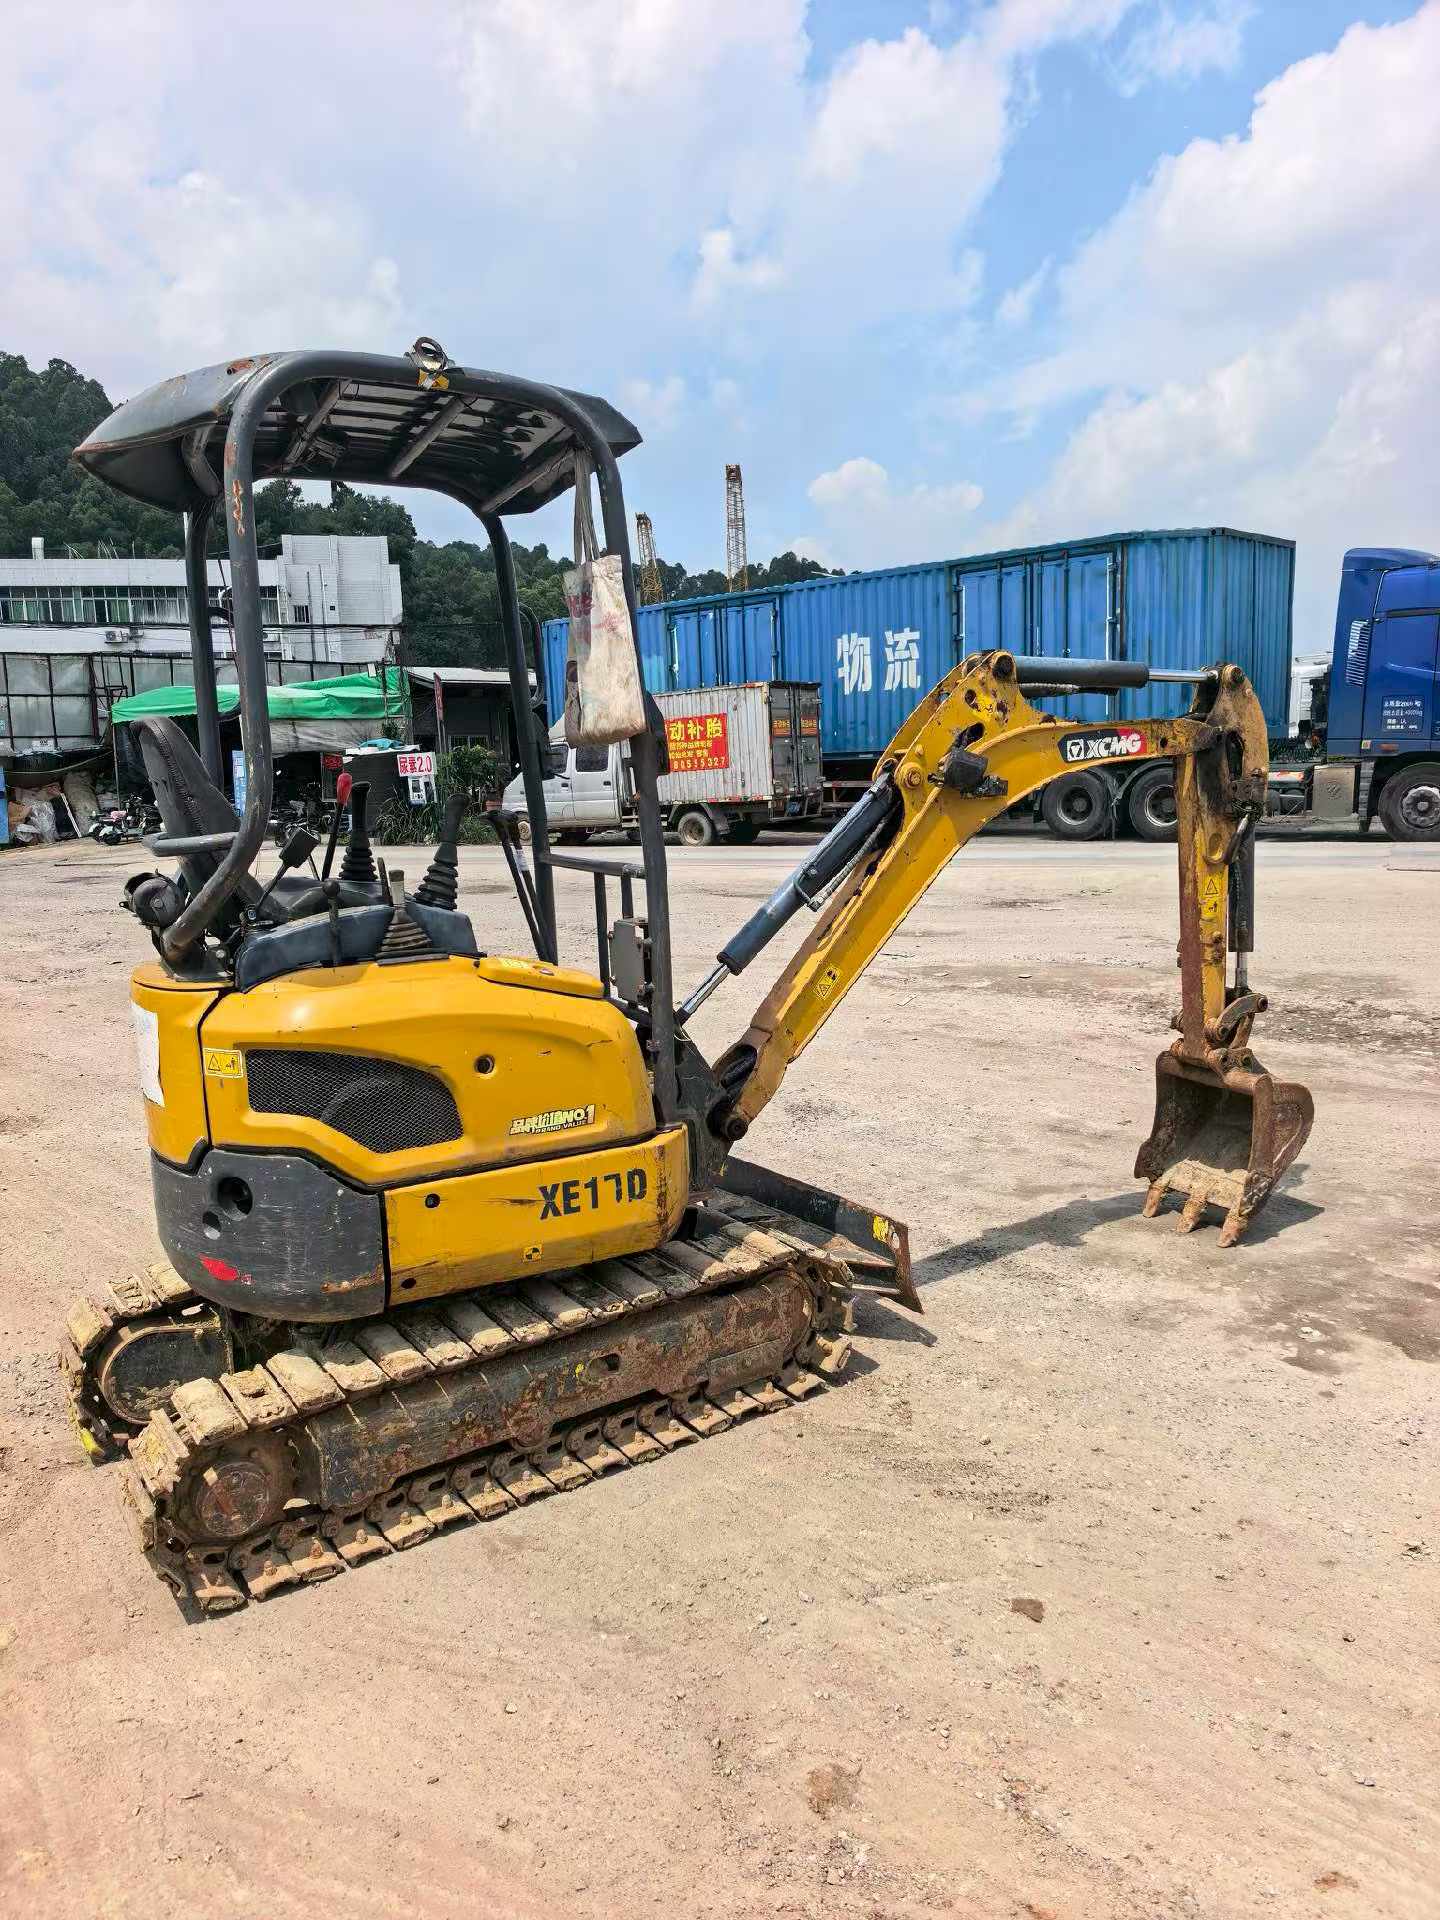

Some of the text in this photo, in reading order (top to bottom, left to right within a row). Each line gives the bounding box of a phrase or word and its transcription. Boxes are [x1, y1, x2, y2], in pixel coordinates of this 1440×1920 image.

[837, 628, 920, 694] 物流
[1086, 734, 1141, 758] XCMG
[538, 1168, 648, 1220] XE17D
